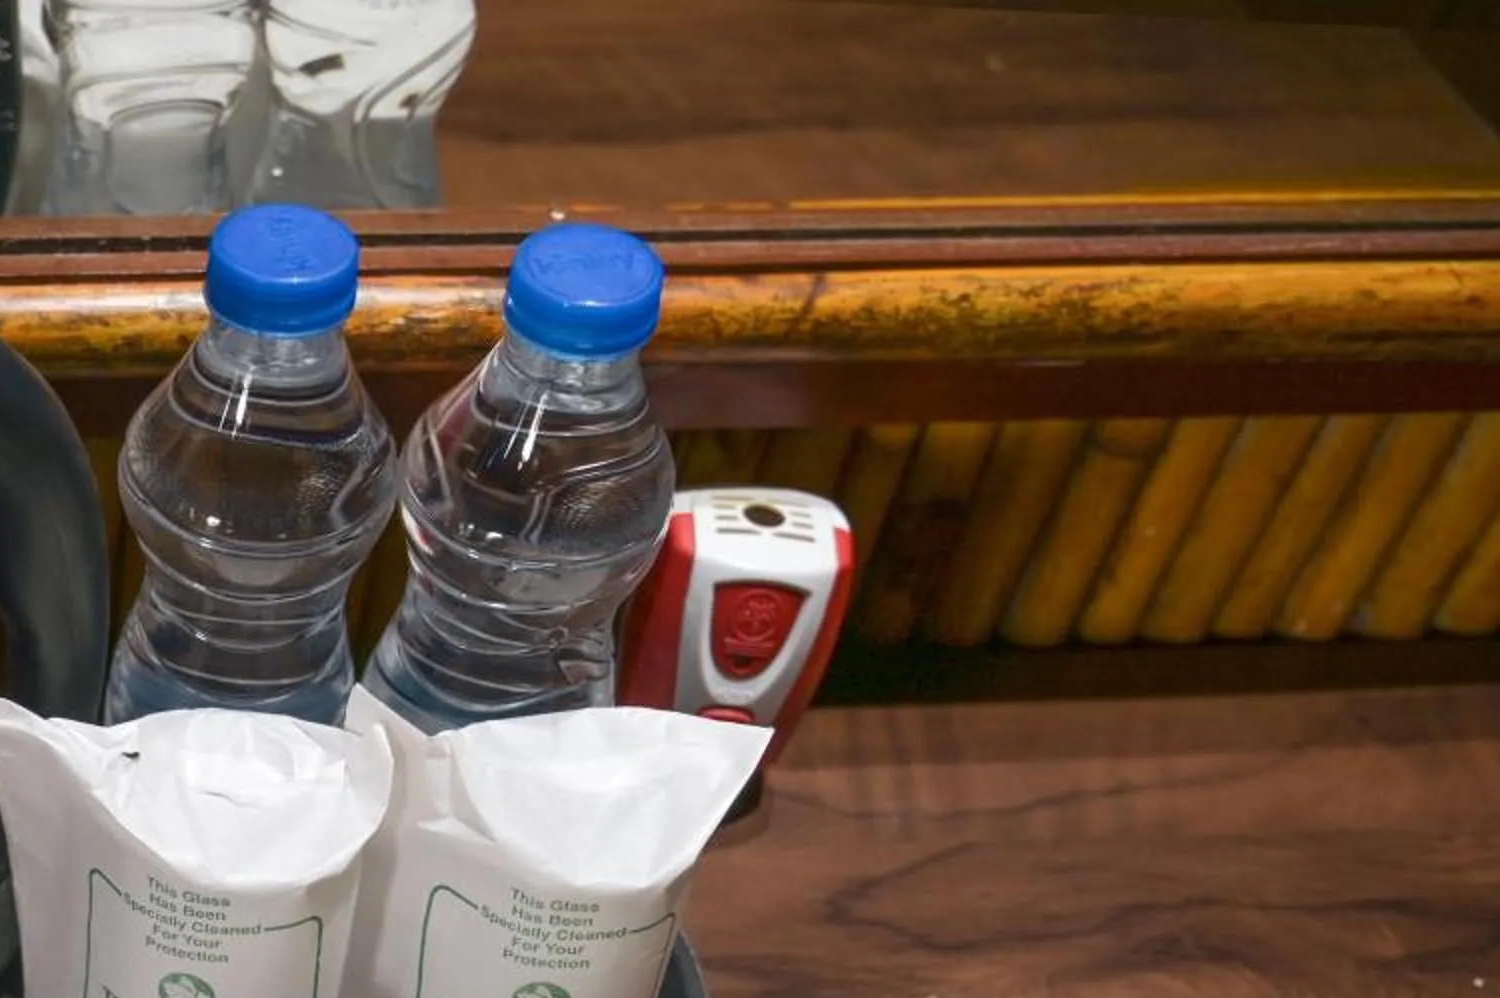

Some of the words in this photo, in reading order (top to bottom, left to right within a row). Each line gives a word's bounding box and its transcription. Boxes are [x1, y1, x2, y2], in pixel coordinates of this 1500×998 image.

[147, 875, 178, 899] This
[182, 890, 232, 908] Glass
[511, 887, 545, 910] This
[550, 899, 601, 913] Glass
[123, 891, 187, 931] Specially
[191, 921, 263, 937] Cleaned
[149, 893, 178, 913] Has
[182, 905, 228, 921] Been
[511, 904, 543, 924] Has
[548, 914, 594, 927] Been
[152, 923, 179, 941] For
[182, 933, 223, 950] Your
[480, 904, 551, 942] Specially
[556, 926, 629, 942] Cleaned
[144, 935, 230, 963] Protection
[502, 946, 591, 970] Protection
[511, 935, 541, 953] For
[545, 943, 586, 956] Your
